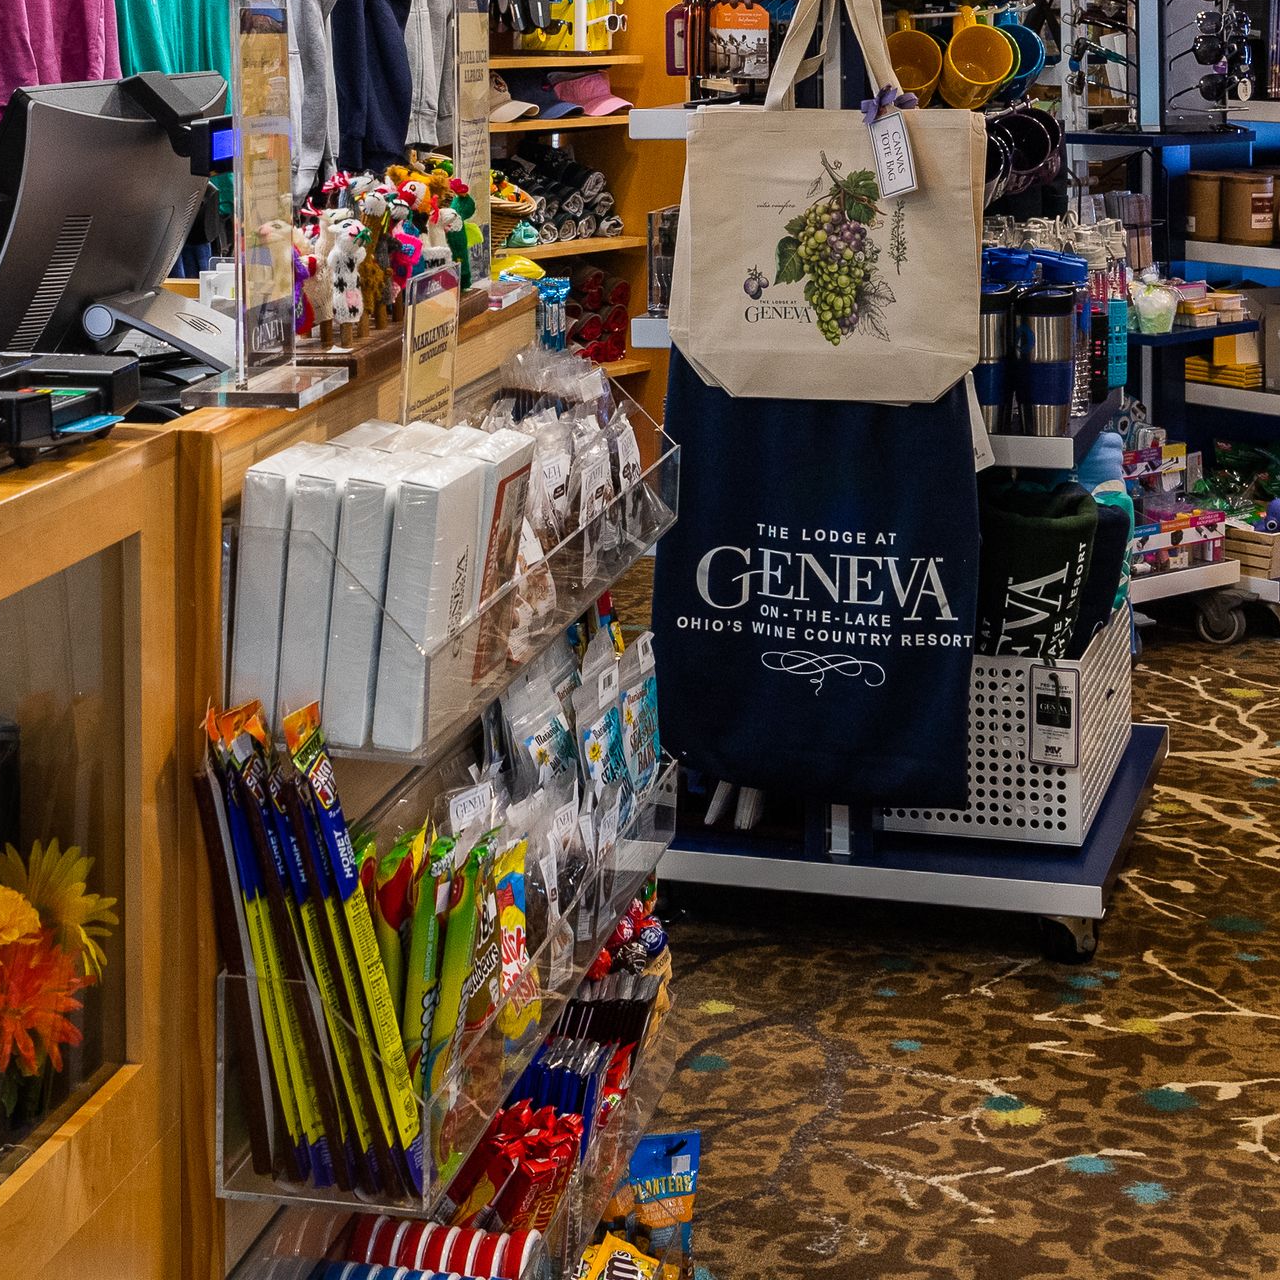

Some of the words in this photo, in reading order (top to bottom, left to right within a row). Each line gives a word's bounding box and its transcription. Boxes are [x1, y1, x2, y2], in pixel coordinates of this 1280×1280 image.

[880, 129, 891, 157] TOTE
[886, 159, 896, 182] BAG
[891, 130, 905, 174] CANVAS
[744, 306, 812, 324] GENEVA
[757, 523, 789, 540] THE
[802, 529, 867, 545] LODGE
[875, 533, 897, 545] AT
[696, 545, 959, 621] GENEVA
[760, 604, 891, 627] ON-THE-LAKE
[677, 616, 743, 633] OHIO'S
[752, 621, 796, 639] WINE
[804, 629, 893, 647] COUNTRY
[901, 634, 973, 648] RESORT
[334, 829, 353, 878] HONEY
[632, 1176, 693, 1201] PLANTERS
